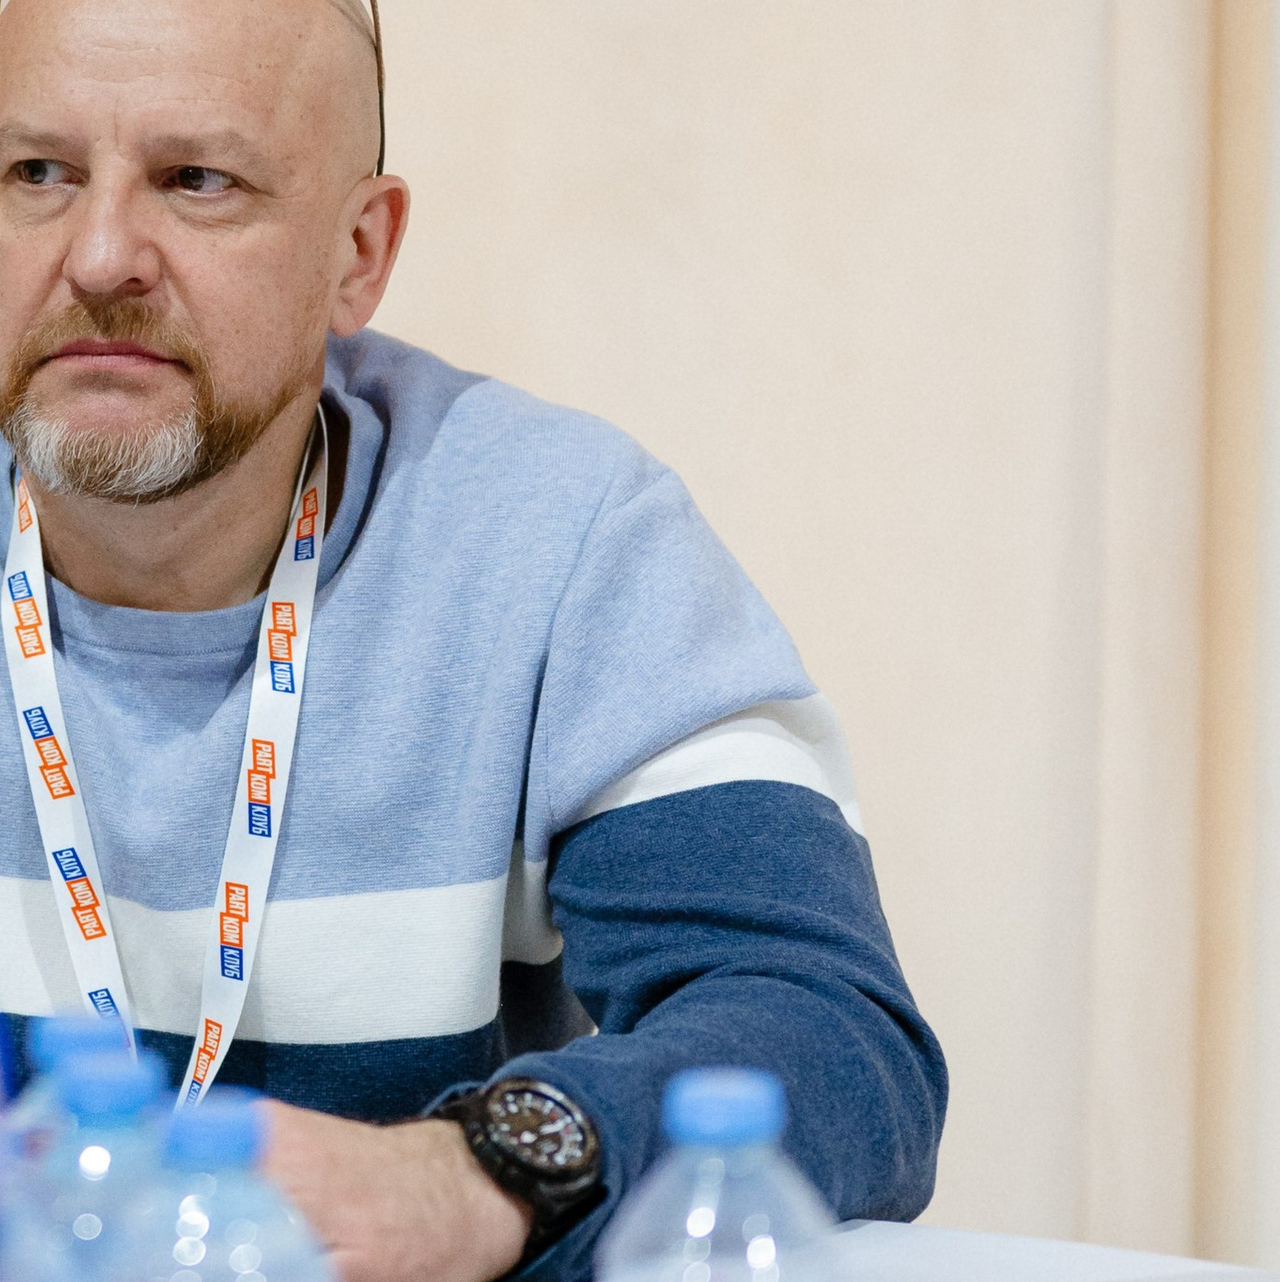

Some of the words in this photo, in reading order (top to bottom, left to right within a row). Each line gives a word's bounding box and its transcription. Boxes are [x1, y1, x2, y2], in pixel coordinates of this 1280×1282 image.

[11, 573, 28, 599] КЛУБ
[273, 663, 292, 692] КЛУБ
[26, 709, 49, 738] КЛУБ
[251, 805, 268, 836] КЛУБ
[55, 850, 83, 879] КЛУБ
[223, 948, 241, 979] КЛУБ
